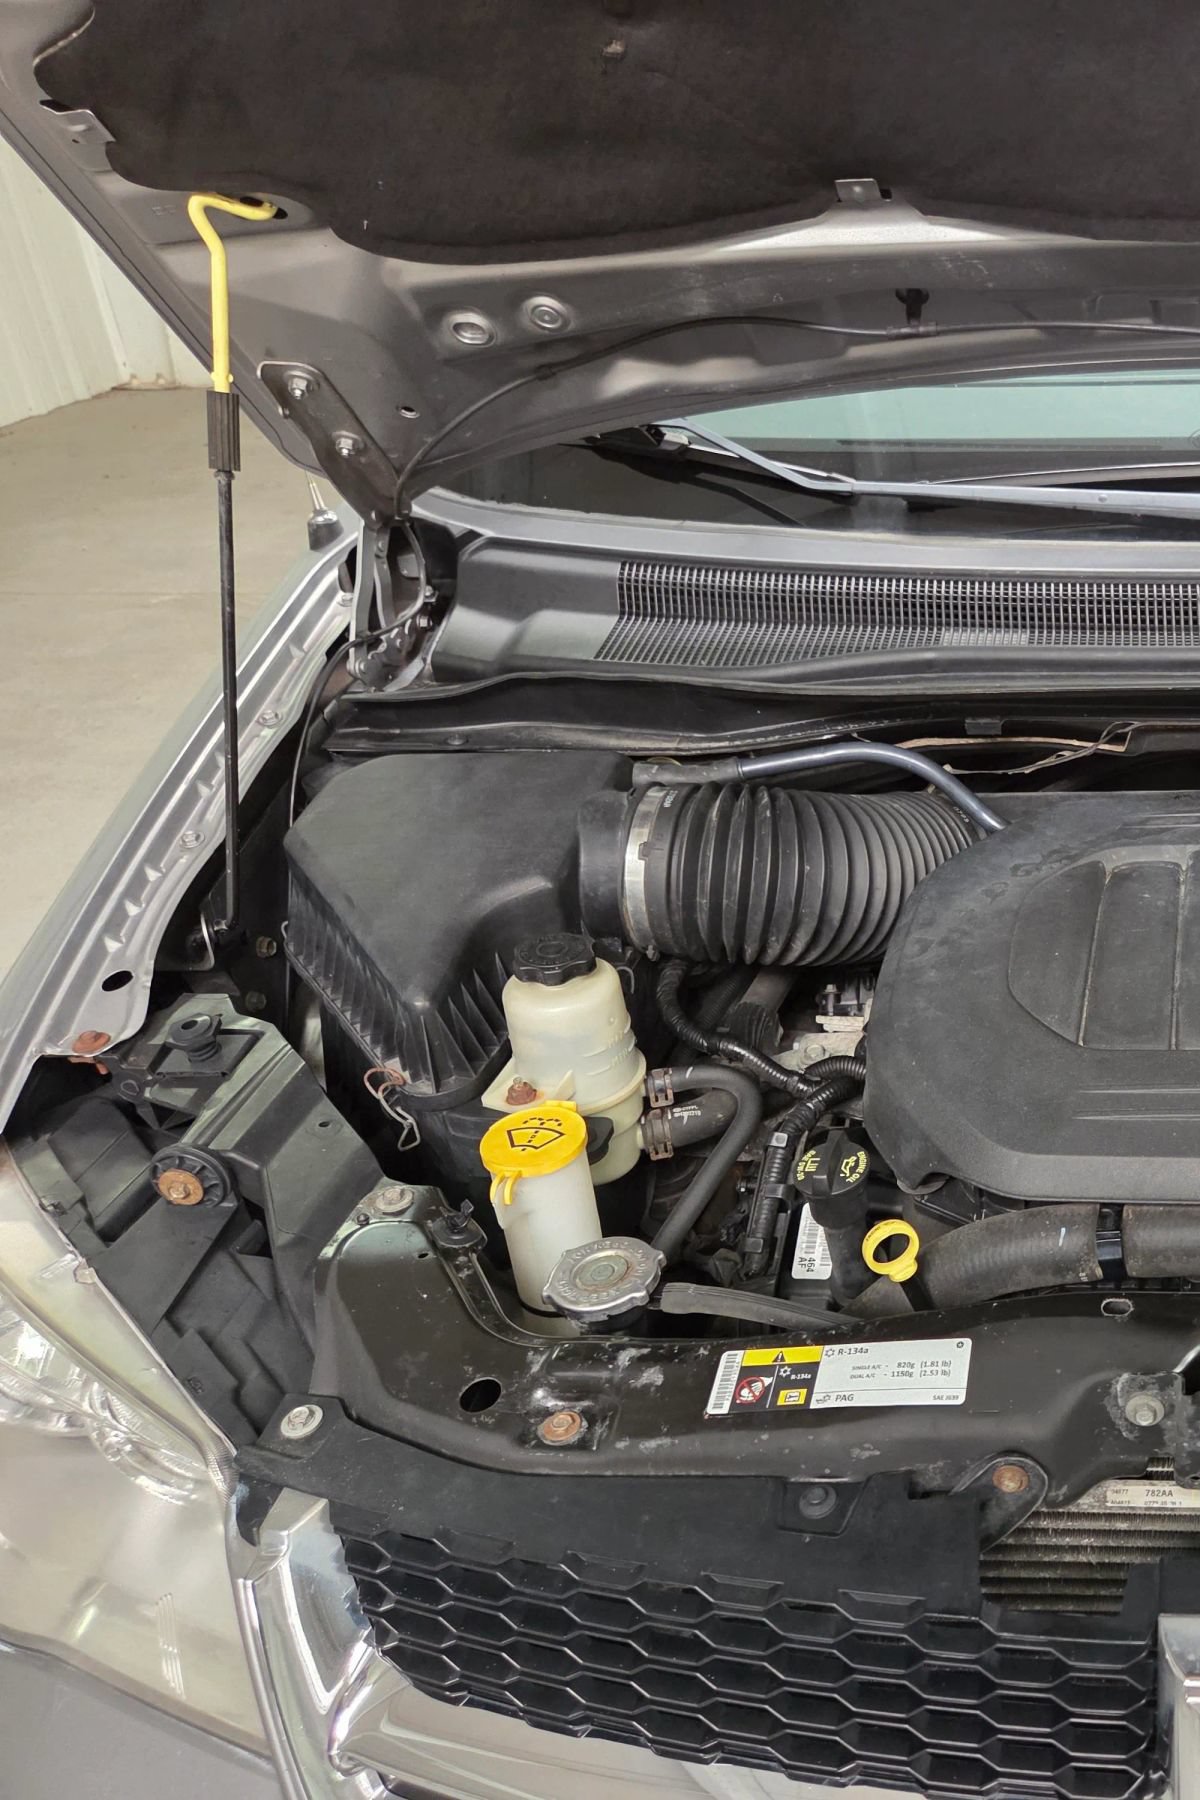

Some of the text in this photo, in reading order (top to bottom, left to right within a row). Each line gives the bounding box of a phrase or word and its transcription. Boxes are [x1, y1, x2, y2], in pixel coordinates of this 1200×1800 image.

[846, 1151, 867, 1183] ENGINE OIL
[798, 1257, 807, 1268] AF
[806, 1257, 816, 1272] 464
[837, 1347, 869, 1356] R-134a
[897, 1362, 915, 1370] 820g
[891, 1370, 914, 1378] 1150g
[920, 1370, 939, 1378] (2.53
[941, 1369, 951, 1377] lb)
[835, 1394, 854, 1402] PAG
[1145, 1489, 1173, 1497] 782AA
